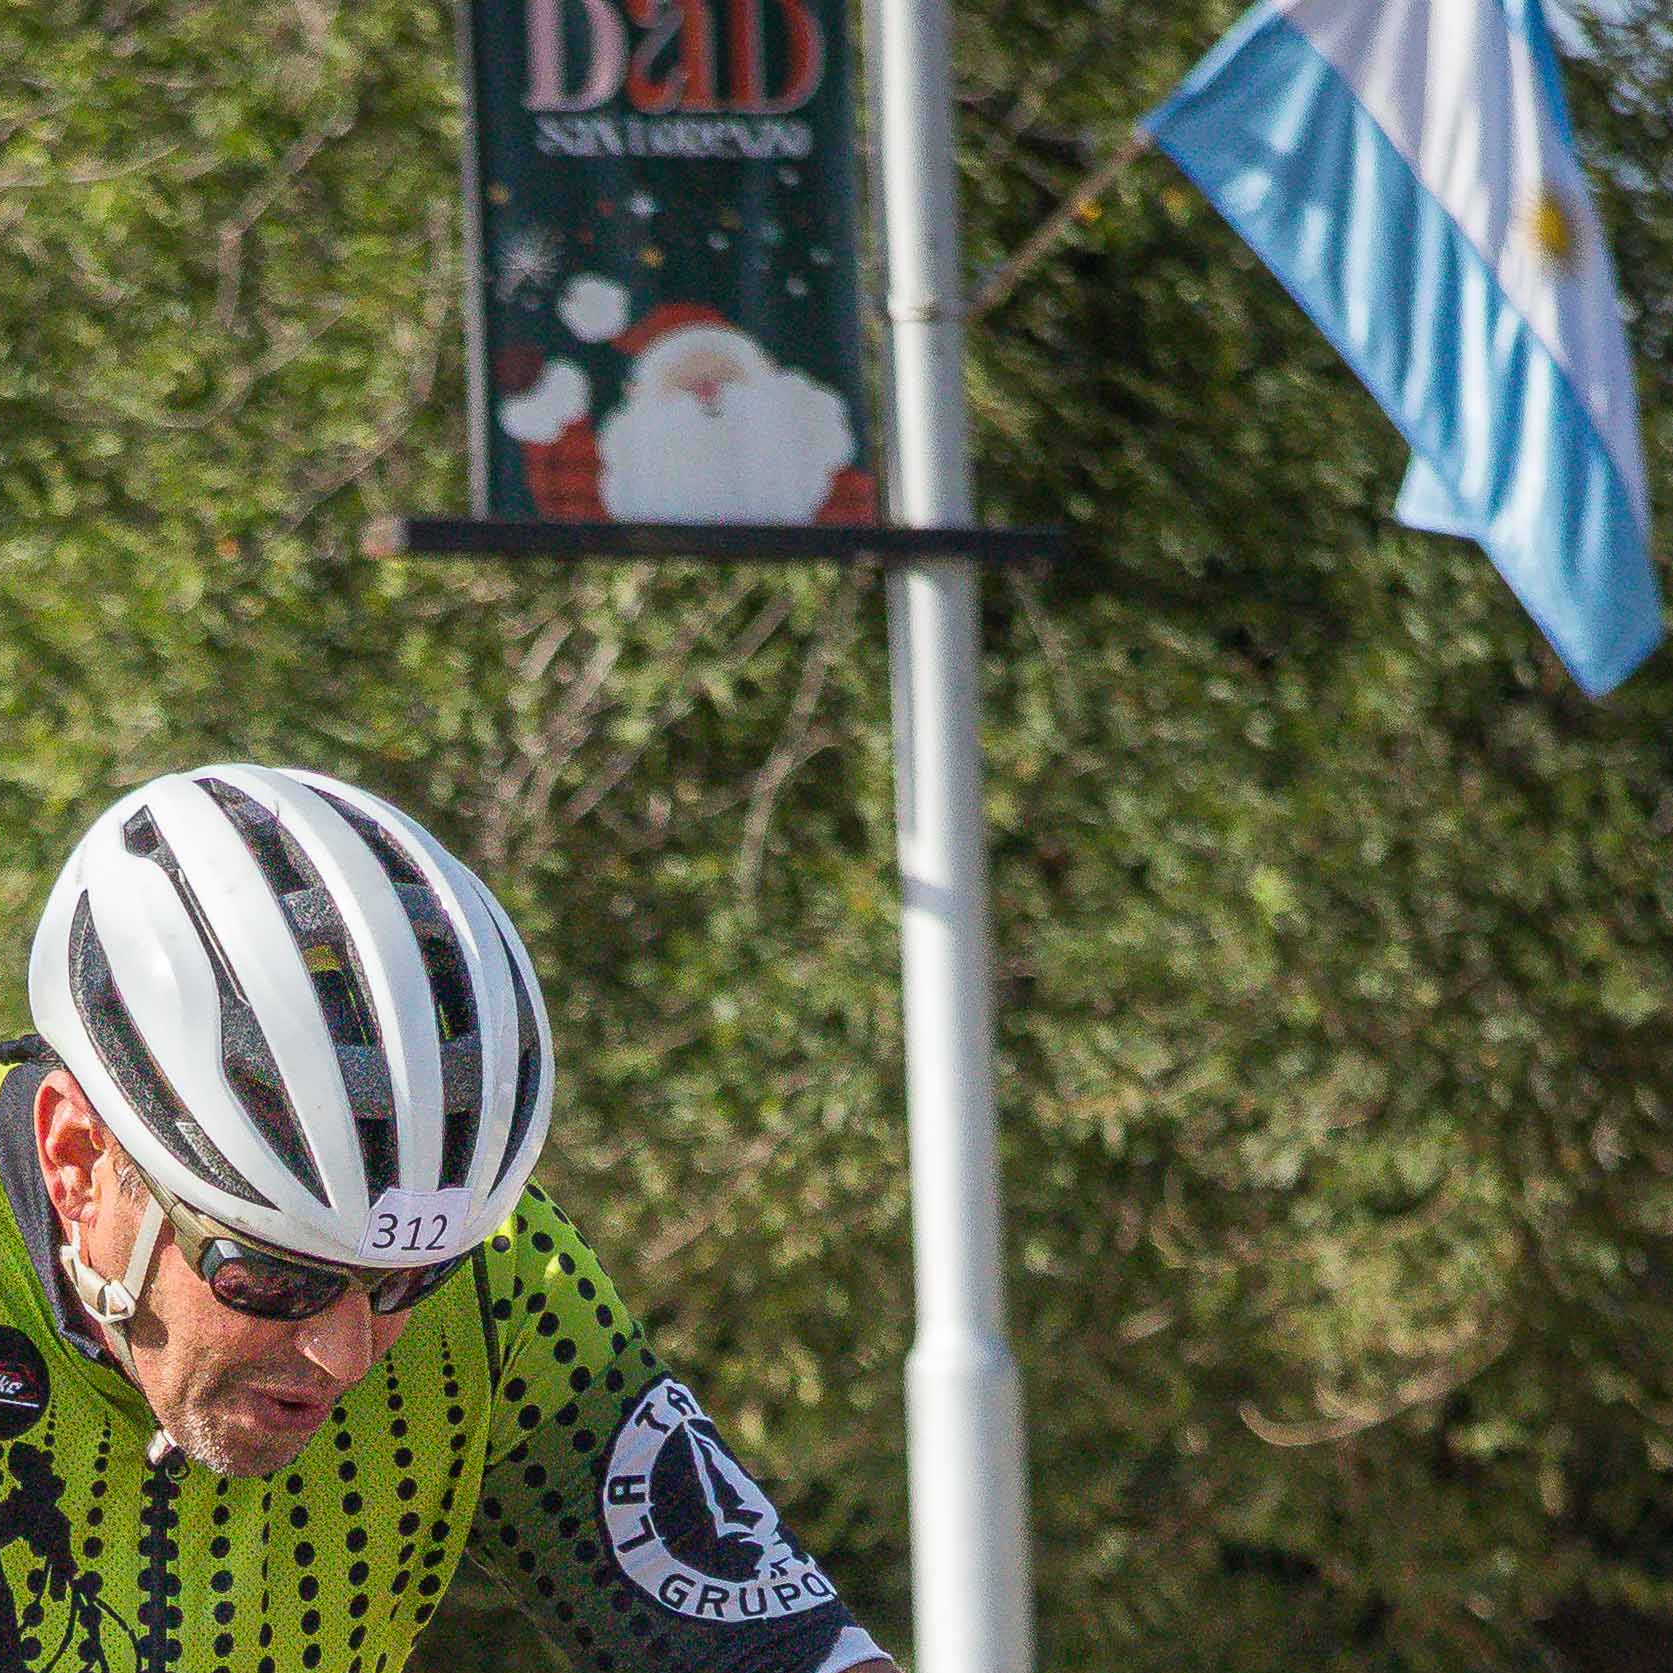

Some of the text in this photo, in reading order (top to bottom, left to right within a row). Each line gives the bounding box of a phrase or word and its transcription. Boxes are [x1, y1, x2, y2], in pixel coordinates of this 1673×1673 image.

[371, 1212, 448, 1251] 312
[607, 1474, 658, 1553] LA
[658, 1571, 838, 1618] GRUPO
